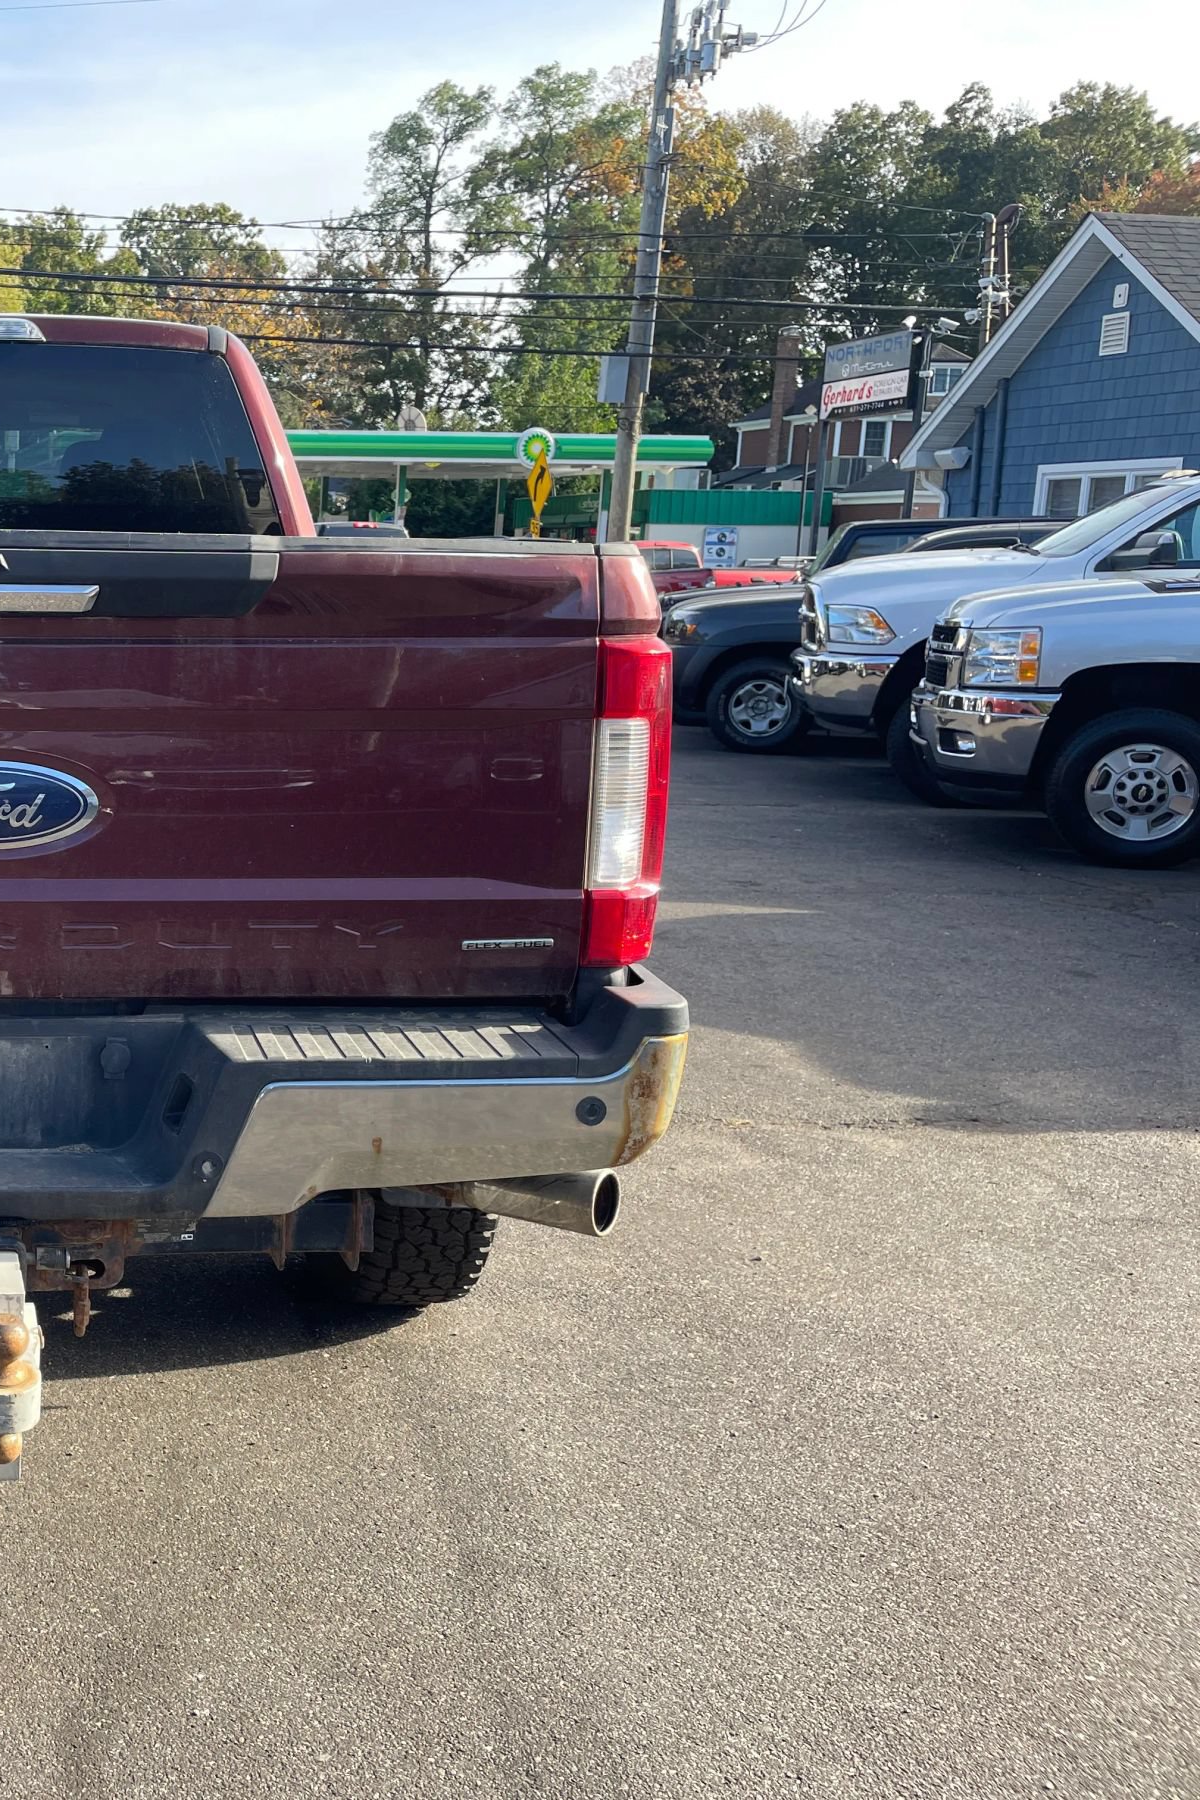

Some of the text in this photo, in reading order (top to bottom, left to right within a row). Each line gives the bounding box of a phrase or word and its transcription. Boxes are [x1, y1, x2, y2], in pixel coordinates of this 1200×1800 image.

[827, 334, 911, 363] NORTHPORT
[823, 381, 873, 412] Gerhard's
[61, 918, 404, 950] DUTY
[466, 940, 551, 950] FLEX FUEL
